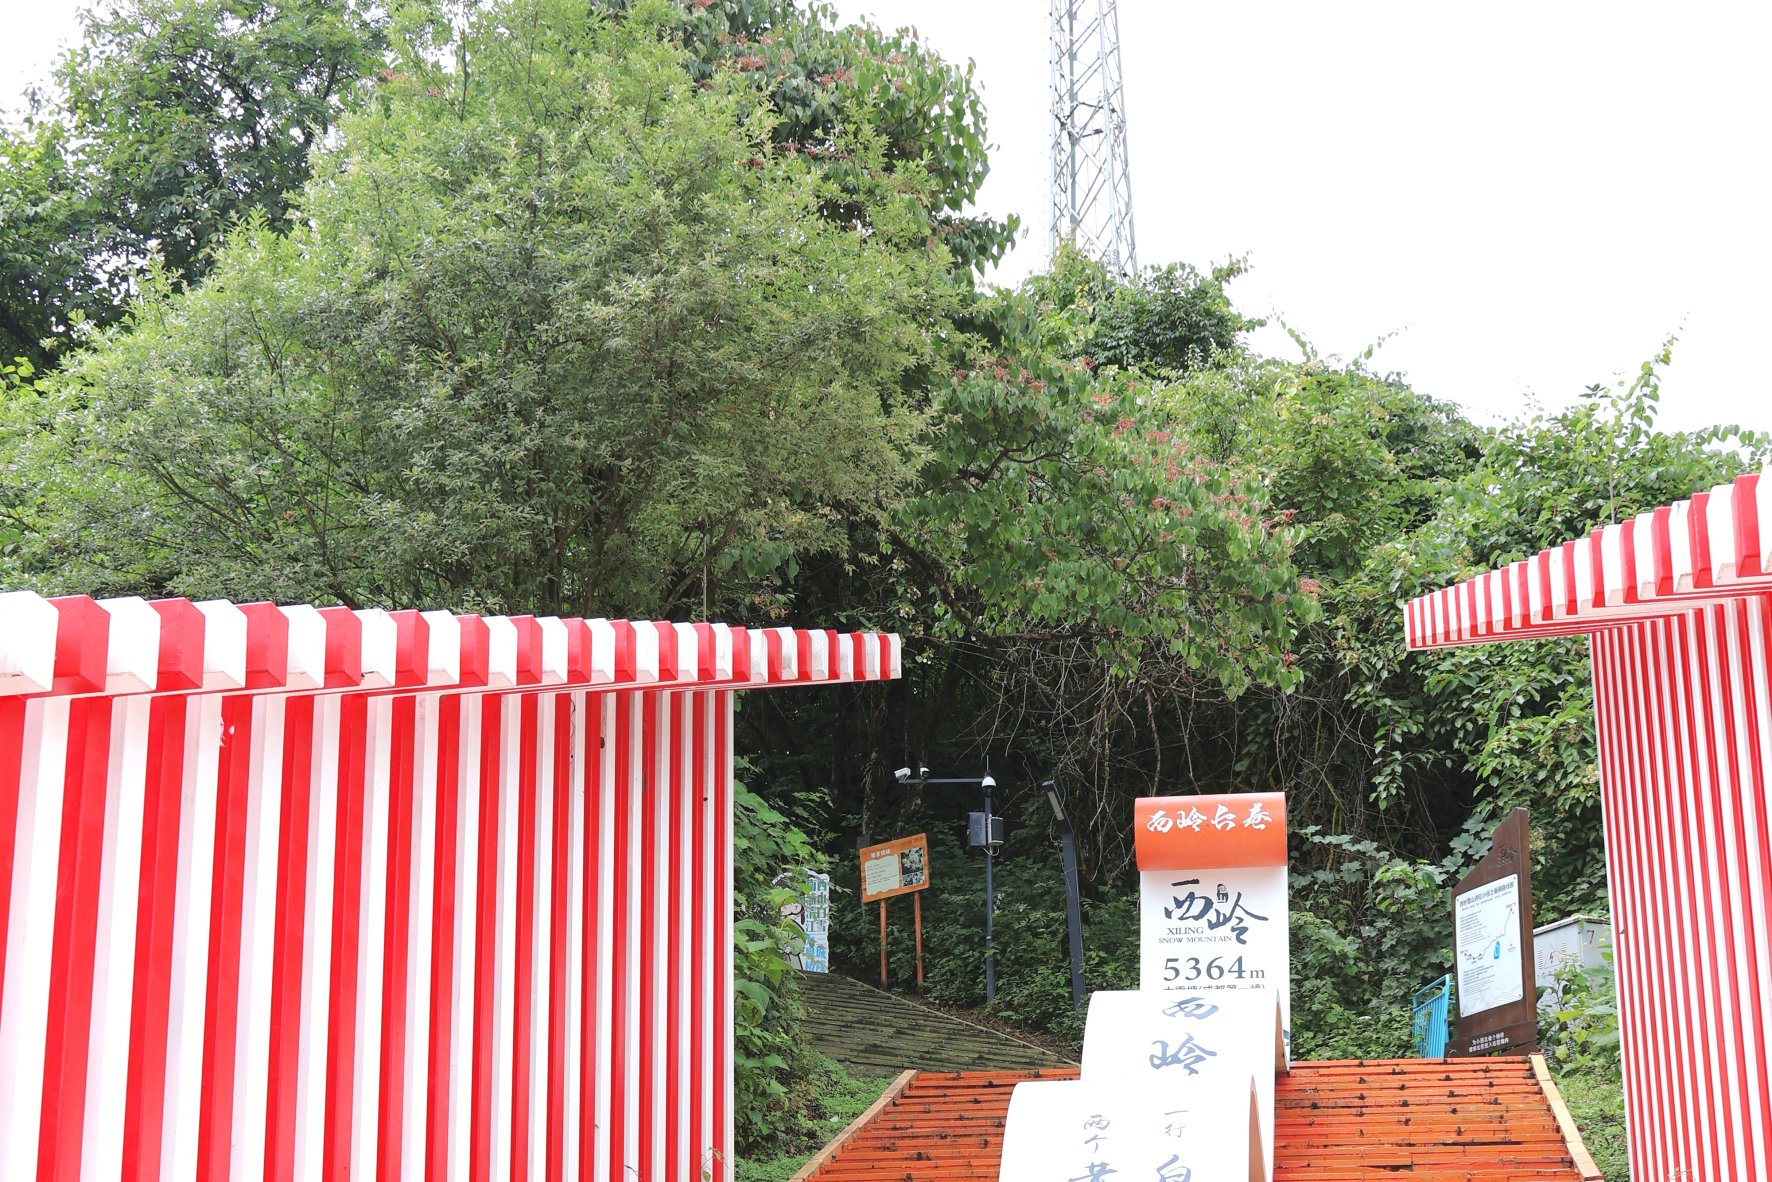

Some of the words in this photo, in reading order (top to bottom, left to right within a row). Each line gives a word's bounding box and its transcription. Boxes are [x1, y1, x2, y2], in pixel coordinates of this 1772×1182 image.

[1147, 802, 1272, 833] 西岭长卷
[1163, 879, 1269, 945] 西岭
[1166, 927, 1204, 935] XILING
[1149, 997, 1219, 1076] 西岭
